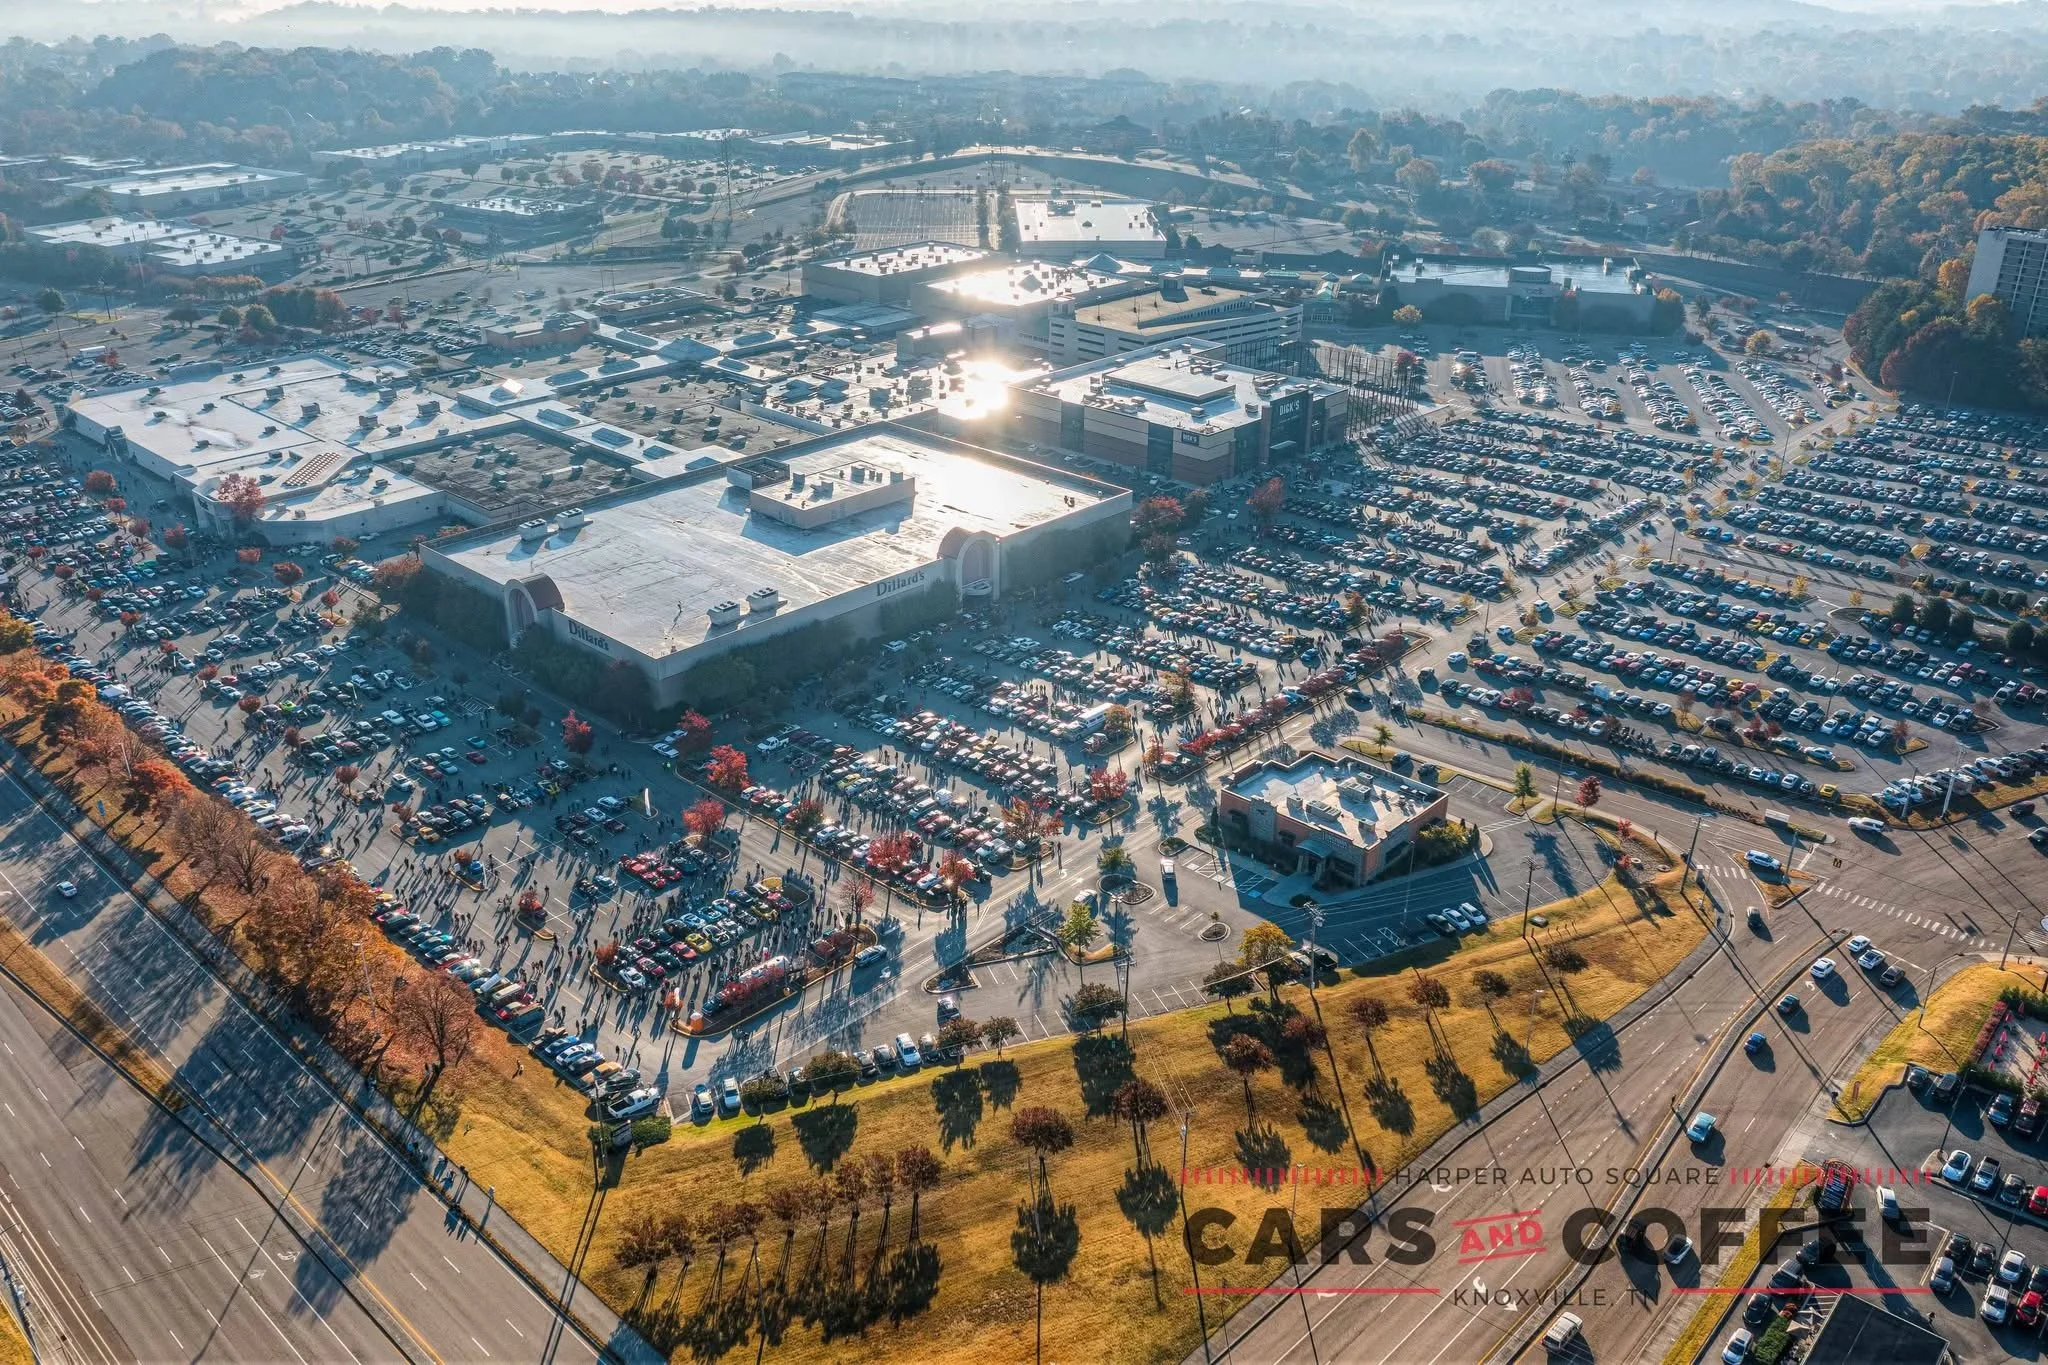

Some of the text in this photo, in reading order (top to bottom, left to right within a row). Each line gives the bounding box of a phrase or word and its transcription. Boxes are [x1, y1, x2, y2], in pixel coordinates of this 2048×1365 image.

[1279, 399, 1300, 416] DICK'S
[876, 570, 925, 597] Dillard's
[568, 619, 609, 651] Dillard's
